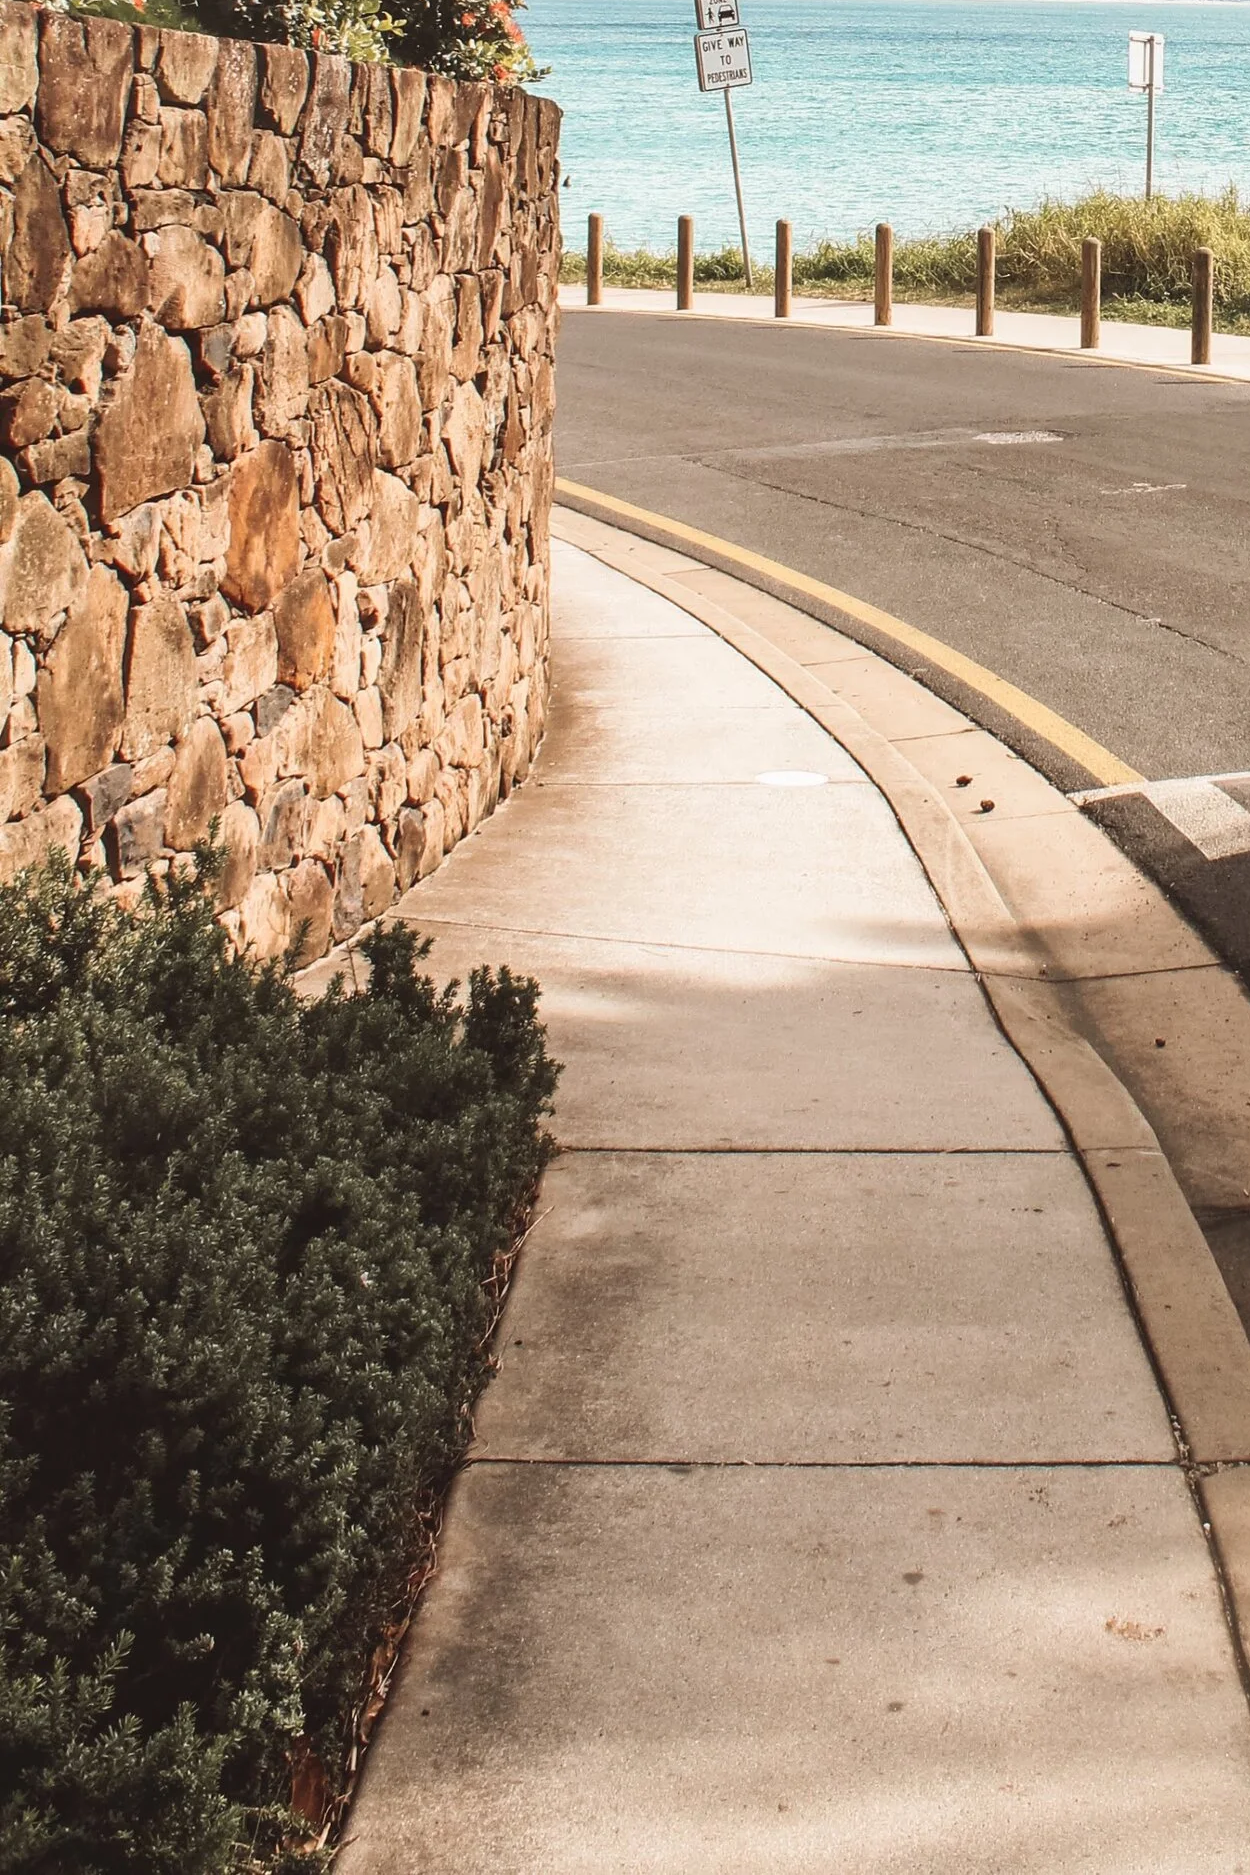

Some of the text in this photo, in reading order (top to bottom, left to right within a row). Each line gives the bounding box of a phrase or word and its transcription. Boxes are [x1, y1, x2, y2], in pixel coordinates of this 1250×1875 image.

[703, 36, 744, 52] GIVE WAY
[720, 55, 732, 65] TO
[707, 68, 748, 84] PEDESTRIANS
